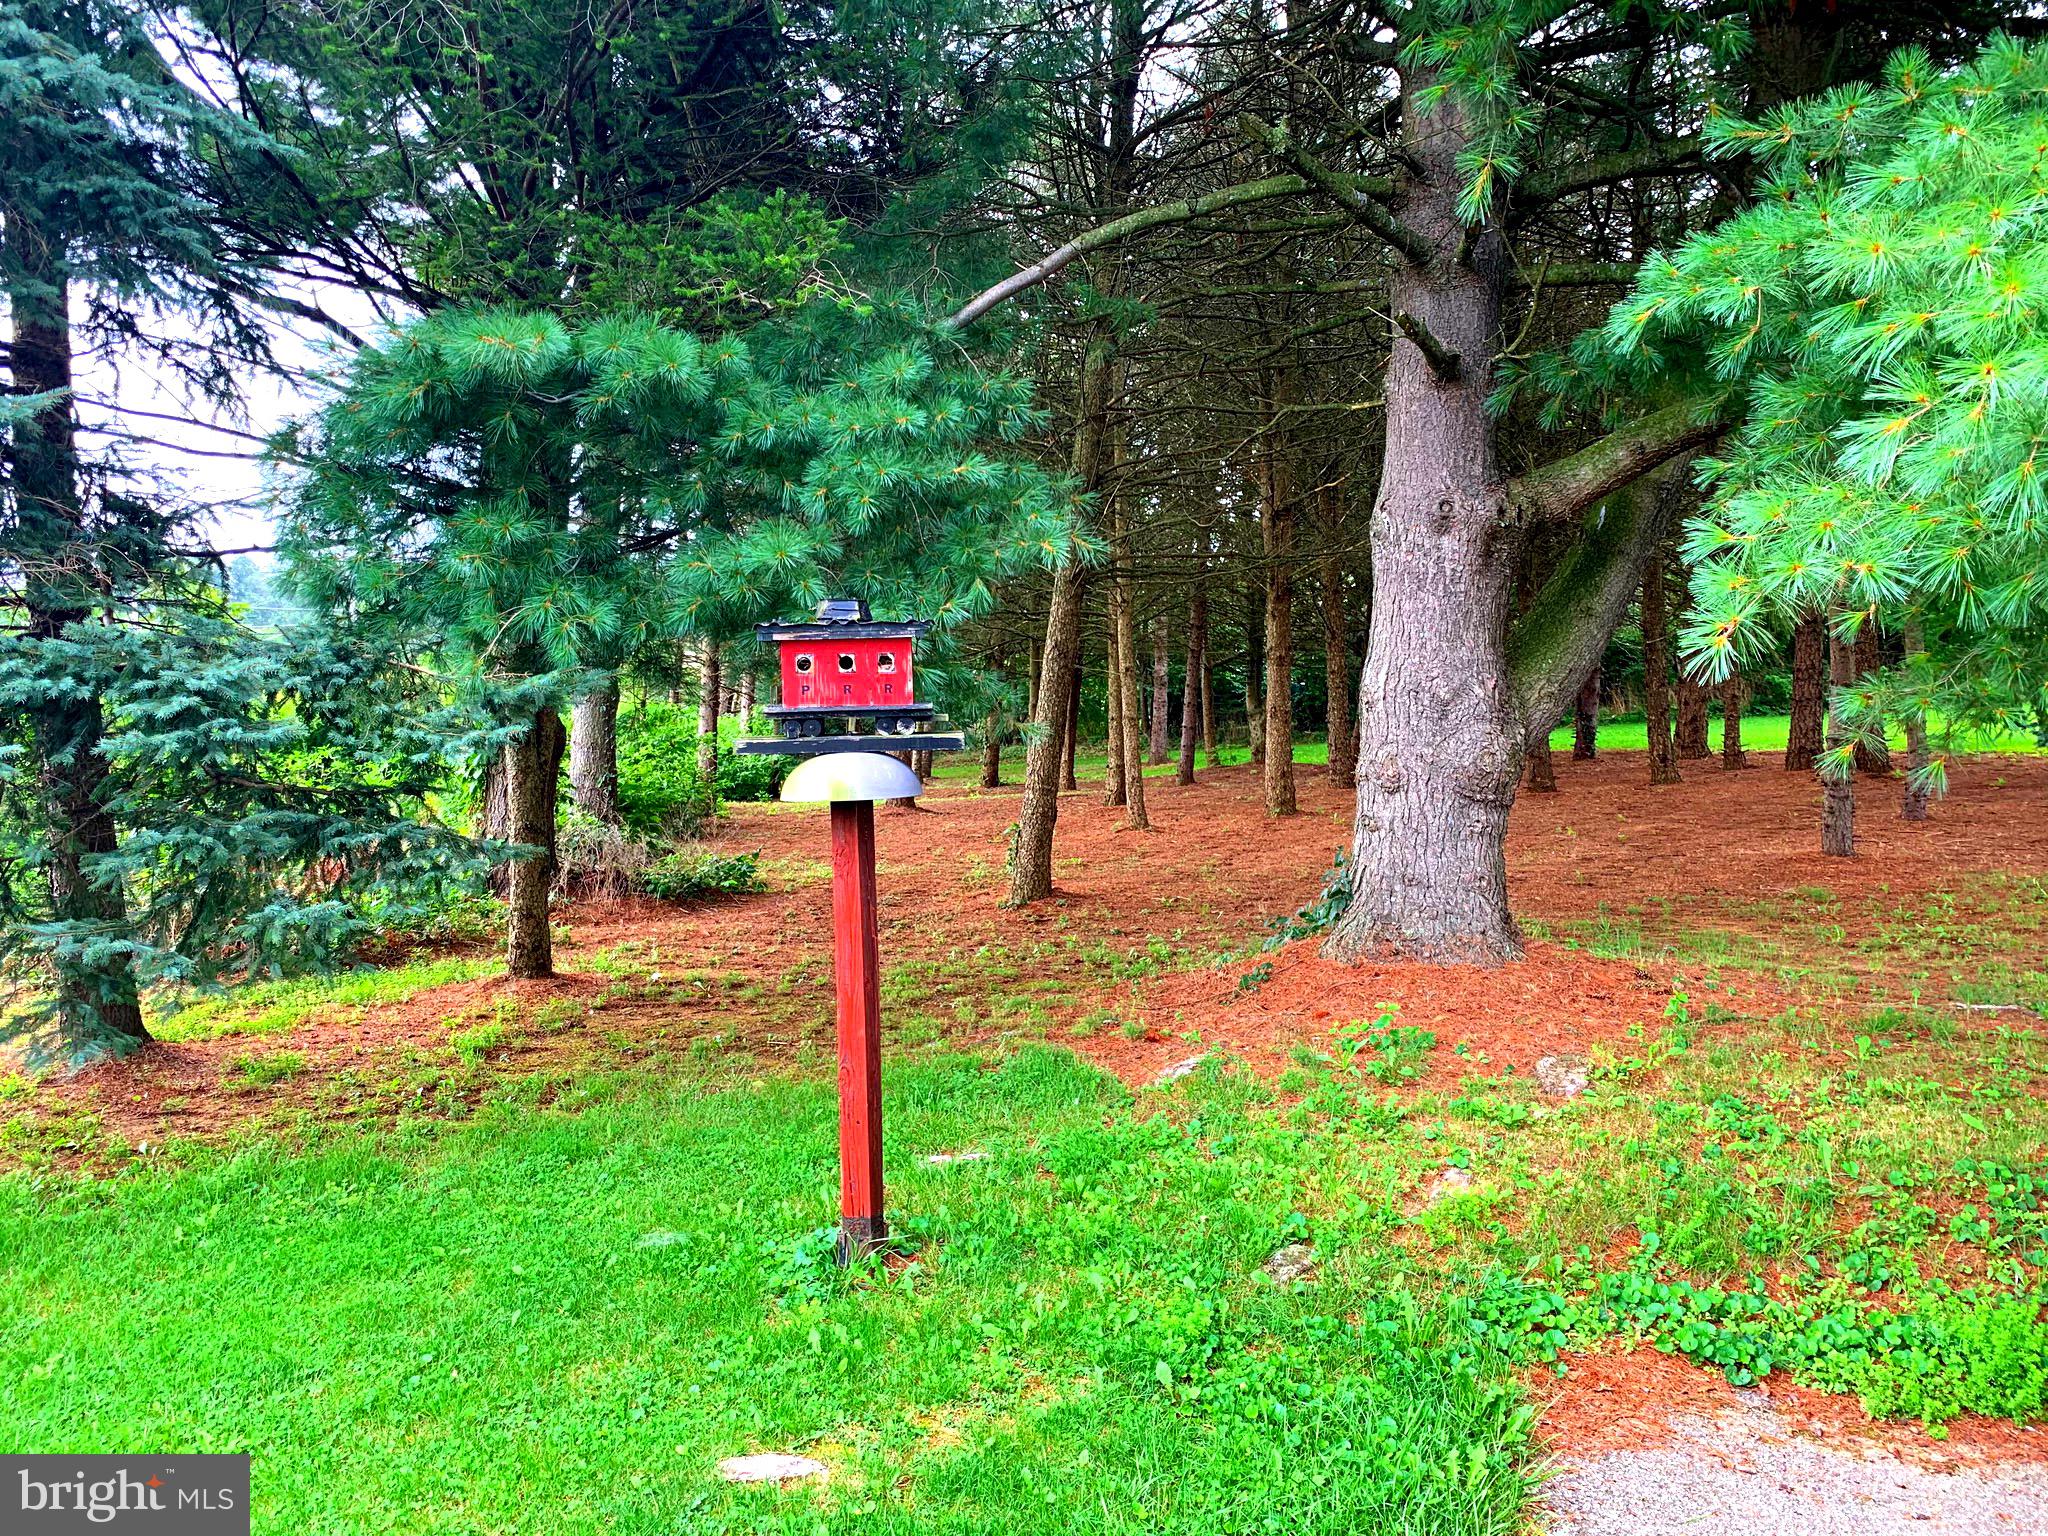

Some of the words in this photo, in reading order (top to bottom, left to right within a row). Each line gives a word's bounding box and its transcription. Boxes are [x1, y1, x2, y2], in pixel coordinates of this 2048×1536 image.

[802, 685, 810, 695] P
[843, 684, 852, 694] R
[884, 683, 893, 694] R
